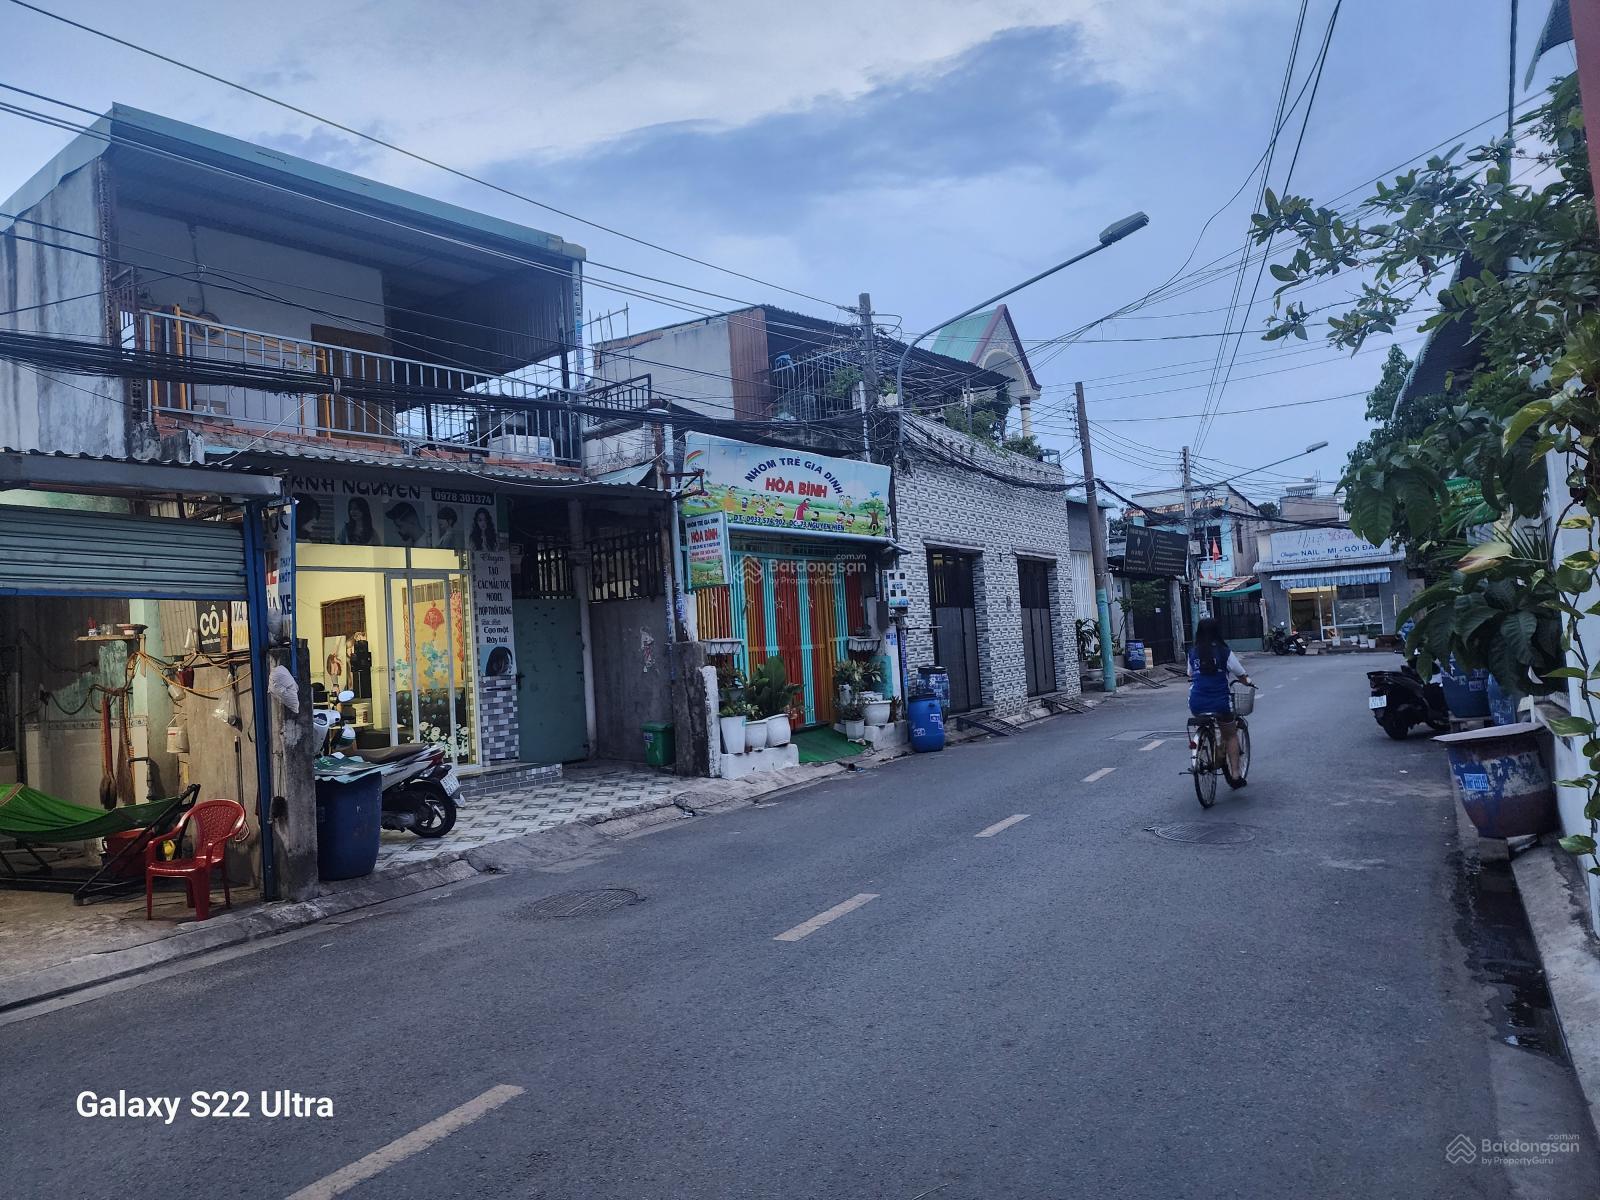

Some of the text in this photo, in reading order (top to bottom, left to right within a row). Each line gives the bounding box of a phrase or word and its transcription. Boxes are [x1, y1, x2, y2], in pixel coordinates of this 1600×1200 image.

[779, 456, 801, 466] TRẺ
[804, 460, 823, 474] GIA
[765, 476, 828, 498] HÒA BÌNH
[1301, 549, 1320, 557] NAIL
